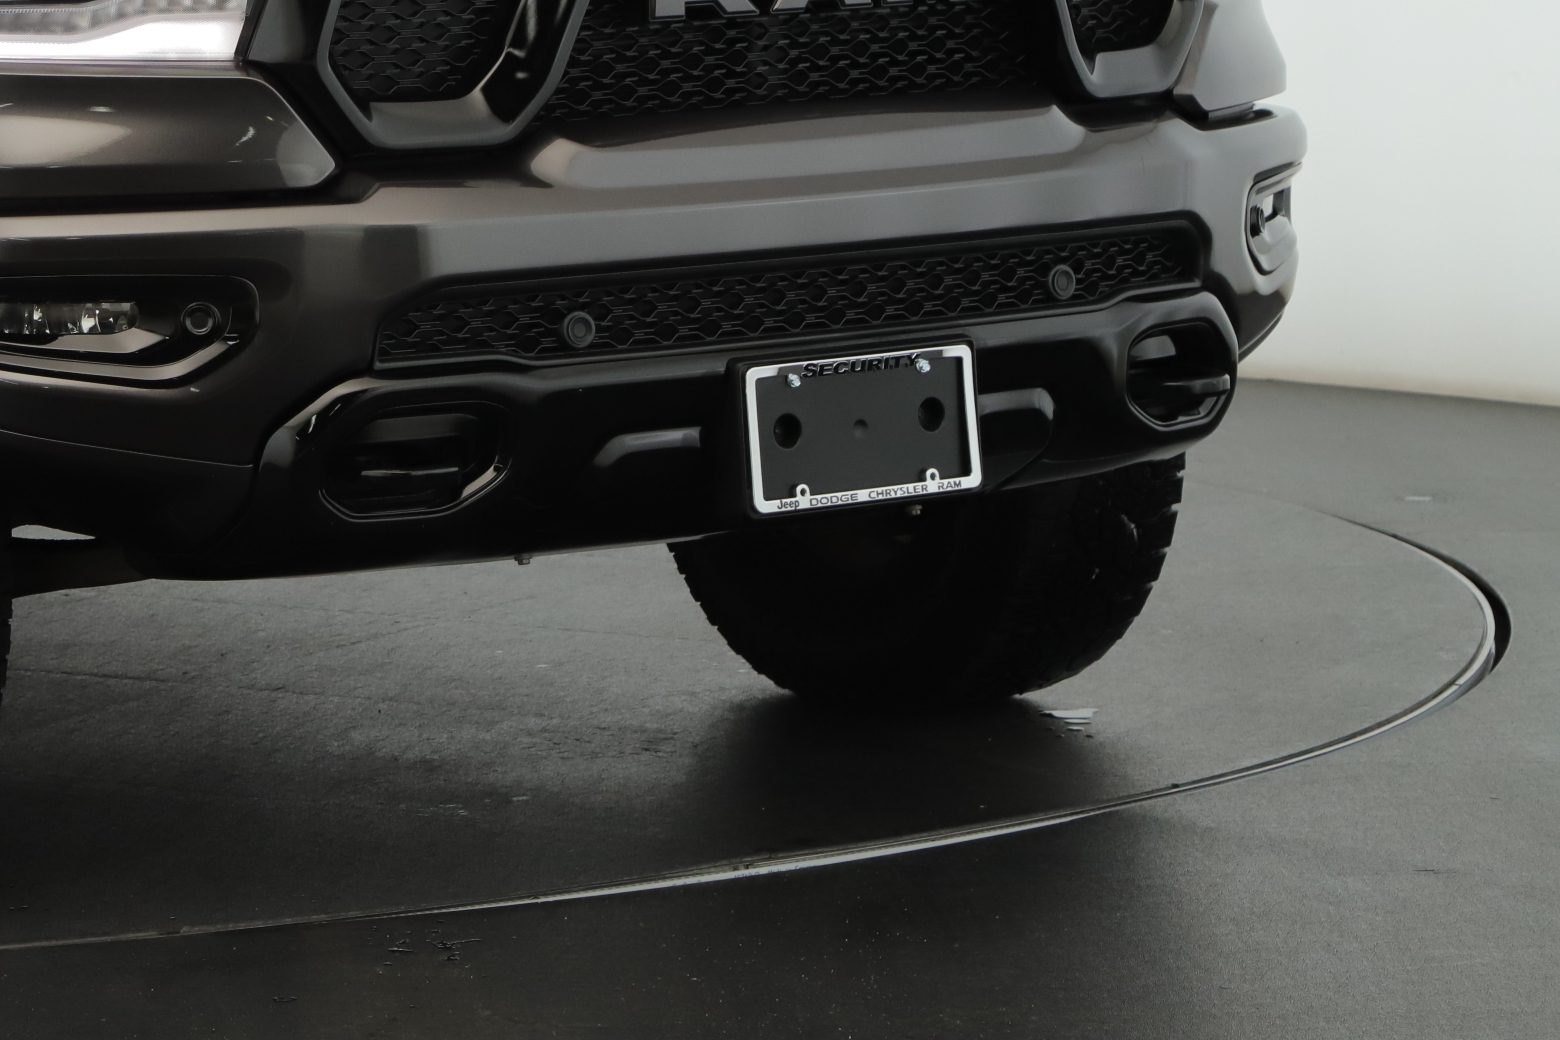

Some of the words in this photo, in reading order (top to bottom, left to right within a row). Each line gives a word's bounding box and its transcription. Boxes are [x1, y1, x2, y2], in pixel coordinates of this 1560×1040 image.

[802, 352, 921, 378] SECURITY
[777, 499, 800, 510] Jeep
[809, 492, 859, 507] DODGE
[868, 484, 929, 500] CHRYSLER
[937, 480, 962, 491] RAM
